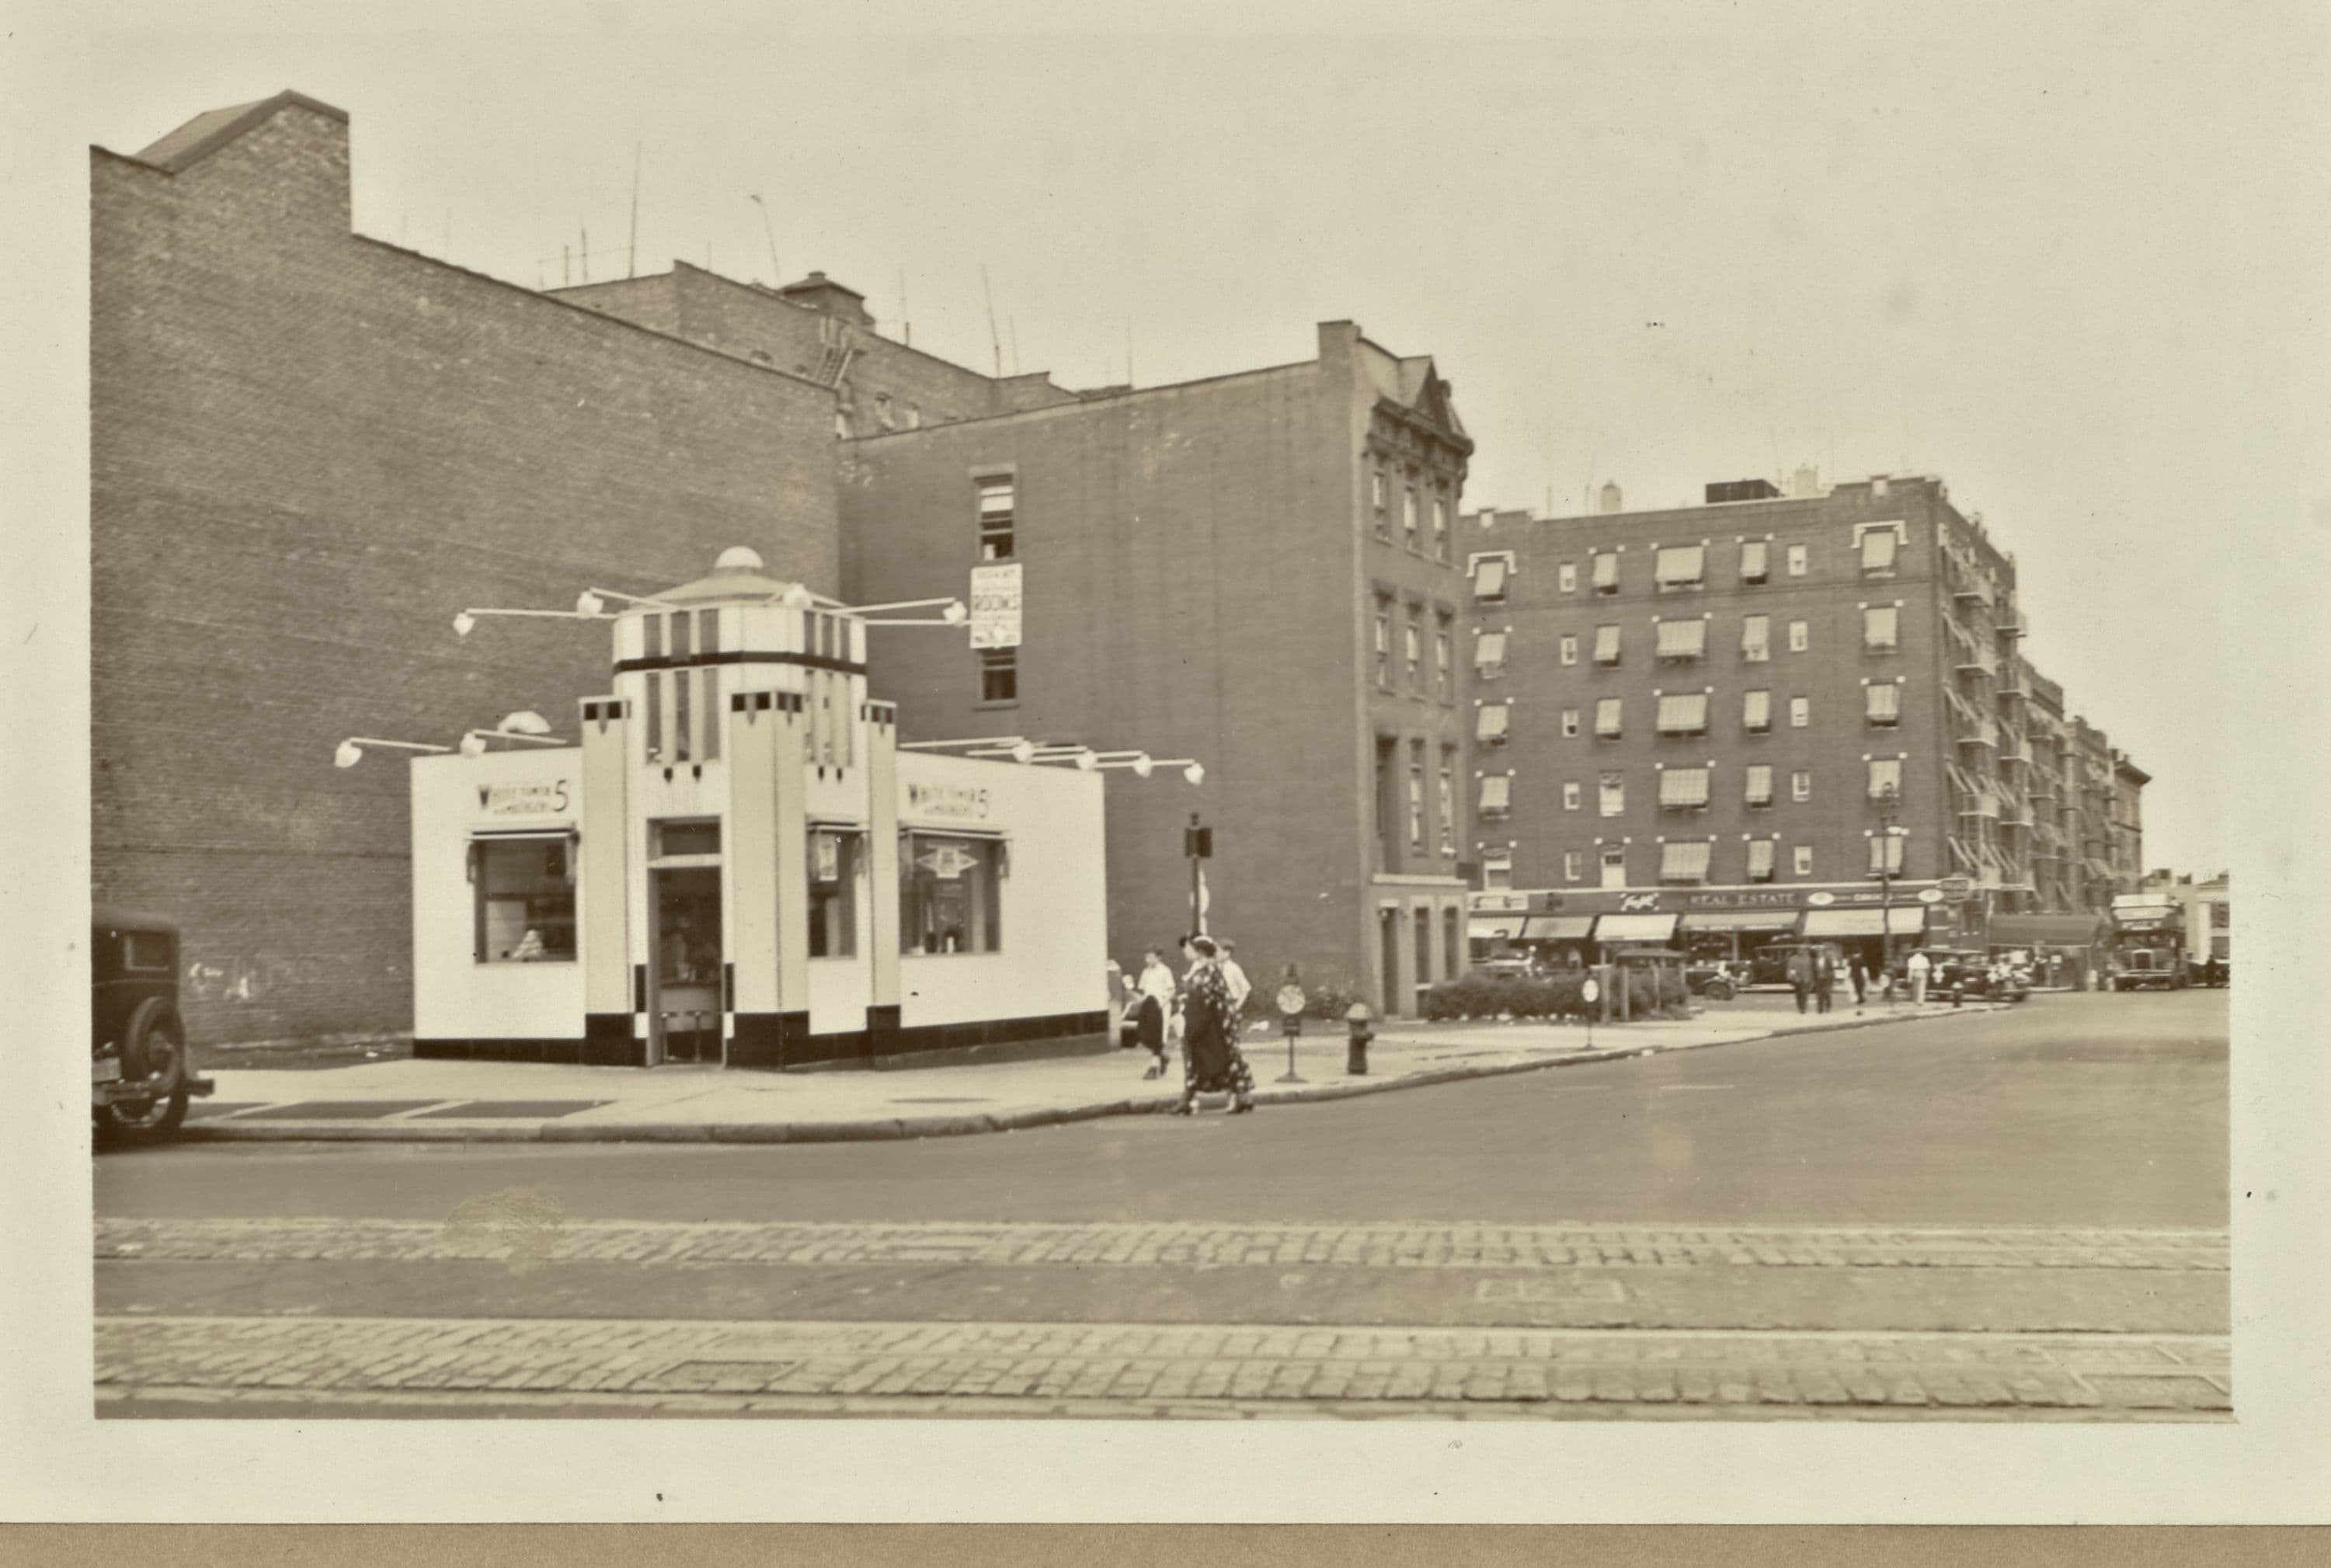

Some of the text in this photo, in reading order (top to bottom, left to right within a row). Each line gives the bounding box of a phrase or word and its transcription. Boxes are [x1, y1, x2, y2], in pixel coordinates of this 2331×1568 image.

[552, 779, 569, 812] 5
[1689, 893, 1797, 906] REAL ESTATE
